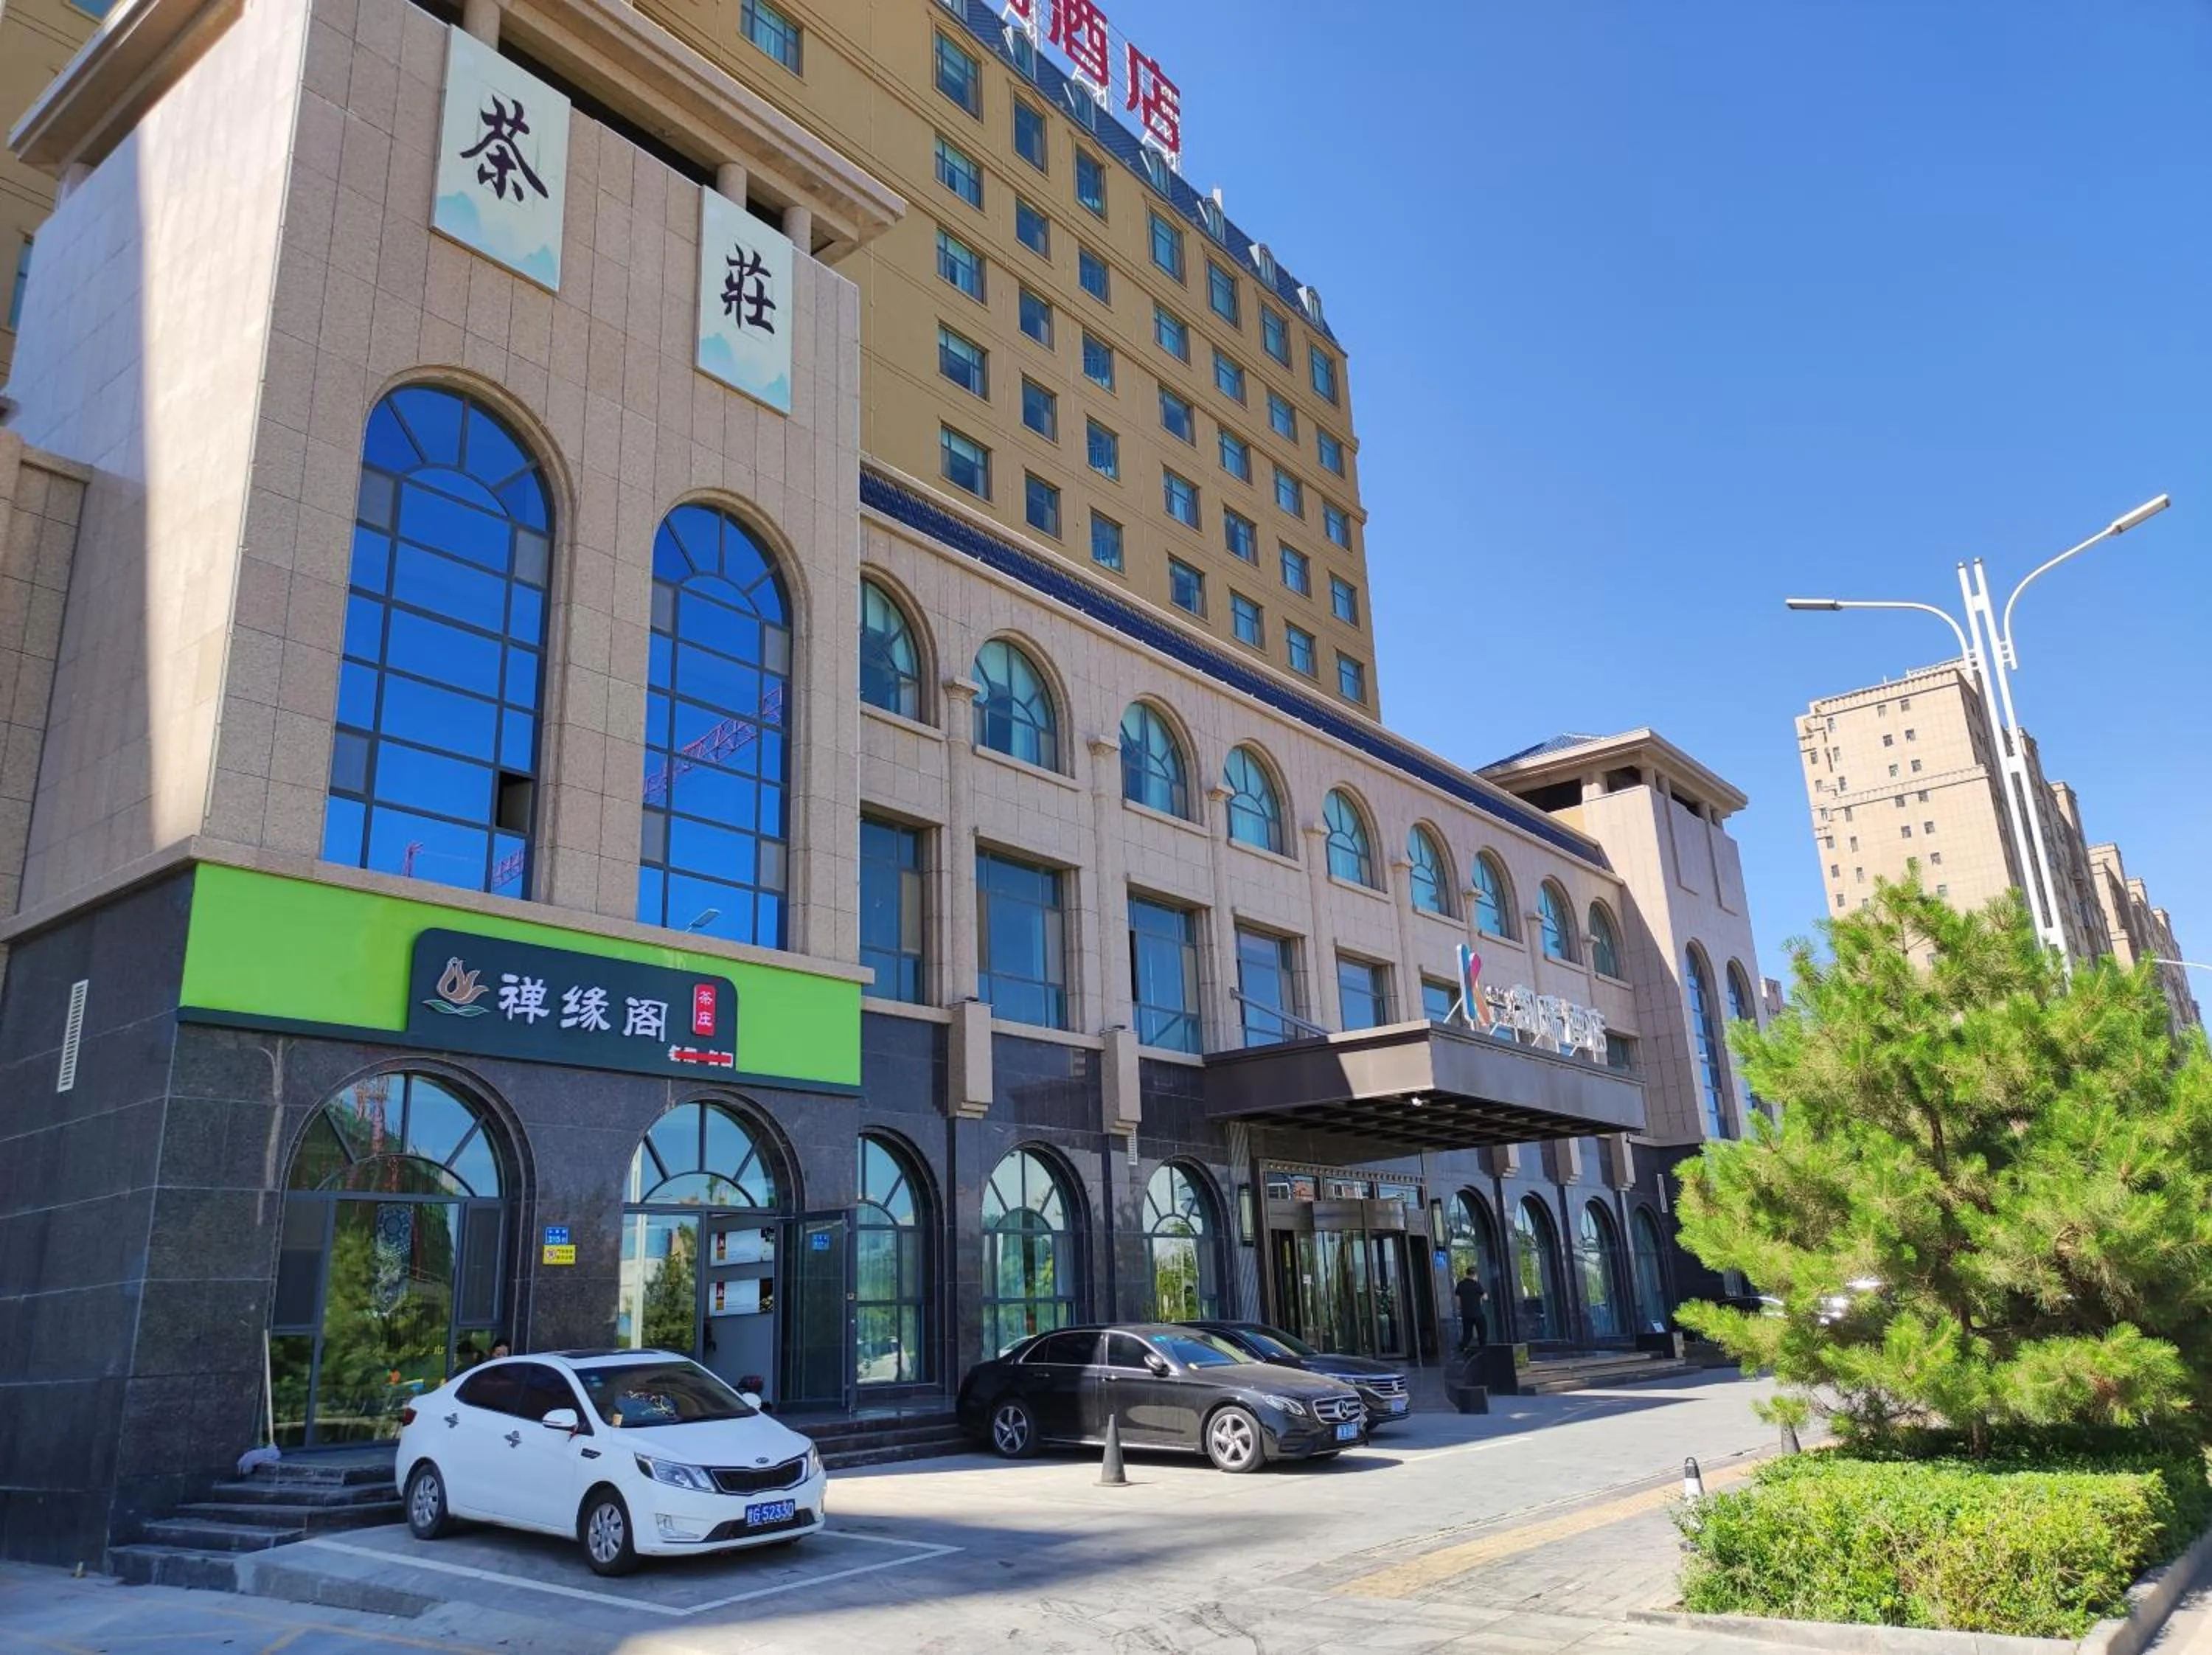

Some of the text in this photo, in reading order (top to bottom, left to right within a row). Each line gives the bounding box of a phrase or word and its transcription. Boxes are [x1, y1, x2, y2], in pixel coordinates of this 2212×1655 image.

[1008, 0, 1180, 153] 酒店
[459, 94, 549, 202] 茶
[497, 972, 669, 1042] 禅缘阁
[697, 990, 713, 1027] 茶庄
